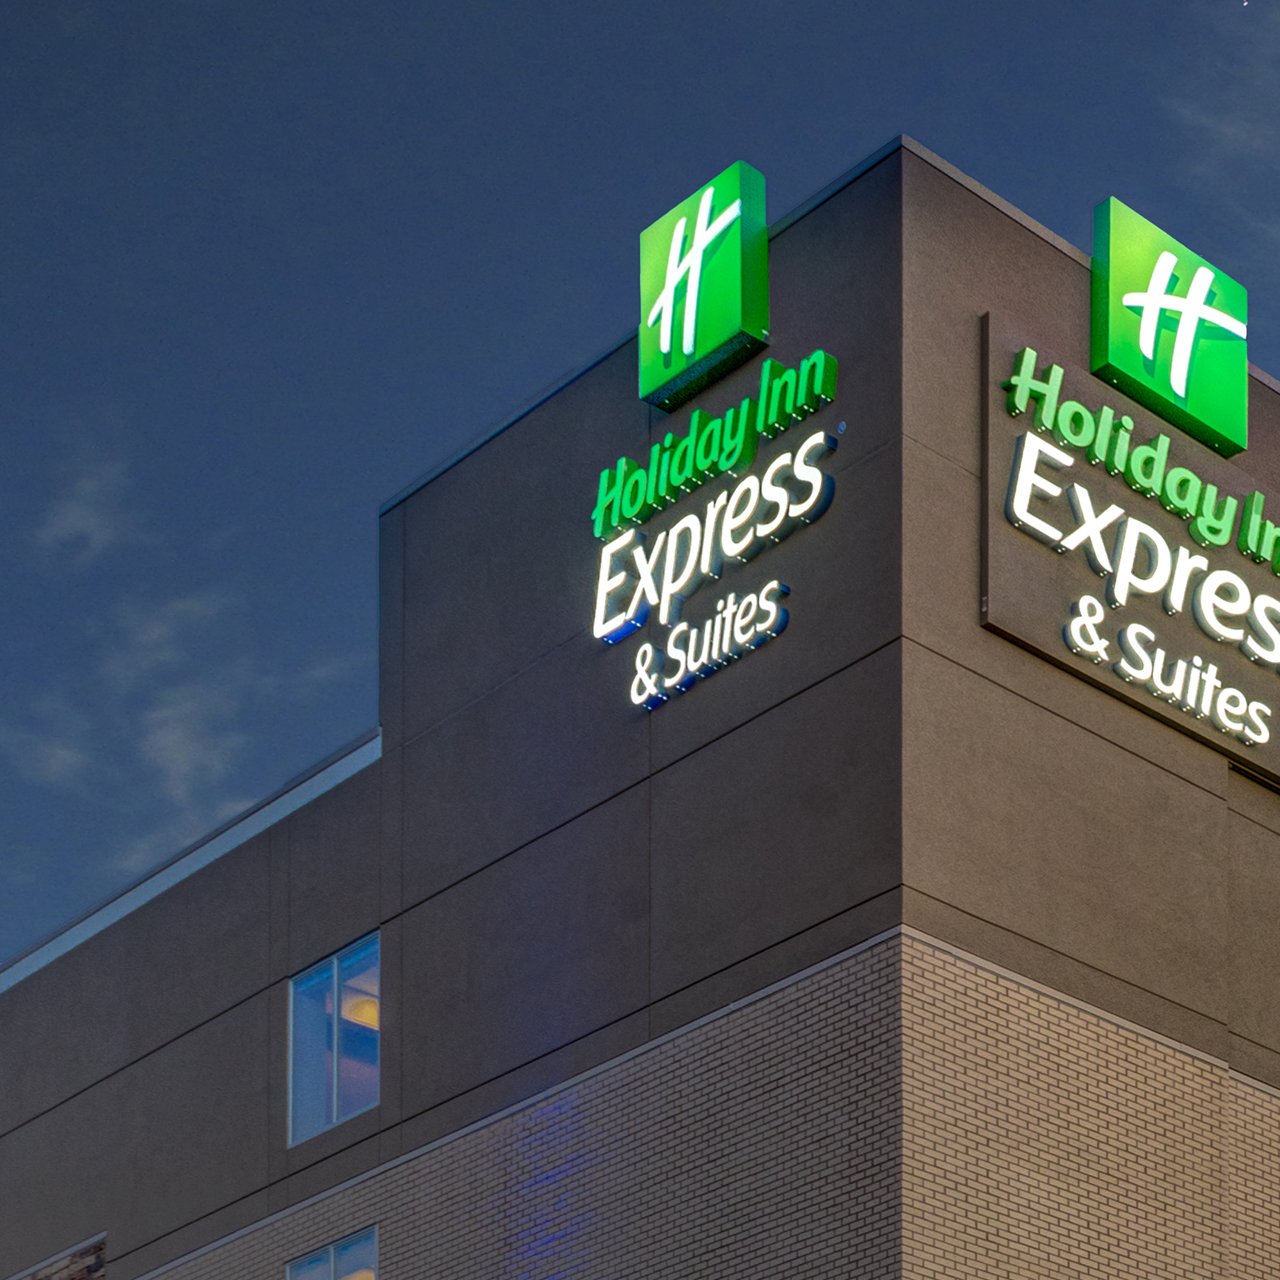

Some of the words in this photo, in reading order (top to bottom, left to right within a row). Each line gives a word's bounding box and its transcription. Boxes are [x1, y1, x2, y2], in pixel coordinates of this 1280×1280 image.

[591, 397, 753, 539] Holiday
[756, 350, 832, 436] Inn
[593, 431, 831, 640] Express
[1006, 347, 1238, 549] Holiday
[630, 642, 662, 706] &
[664, 580, 782, 688] Suites
[1067, 595, 1110, 664] &
[1118, 623, 1272, 744] Suites
